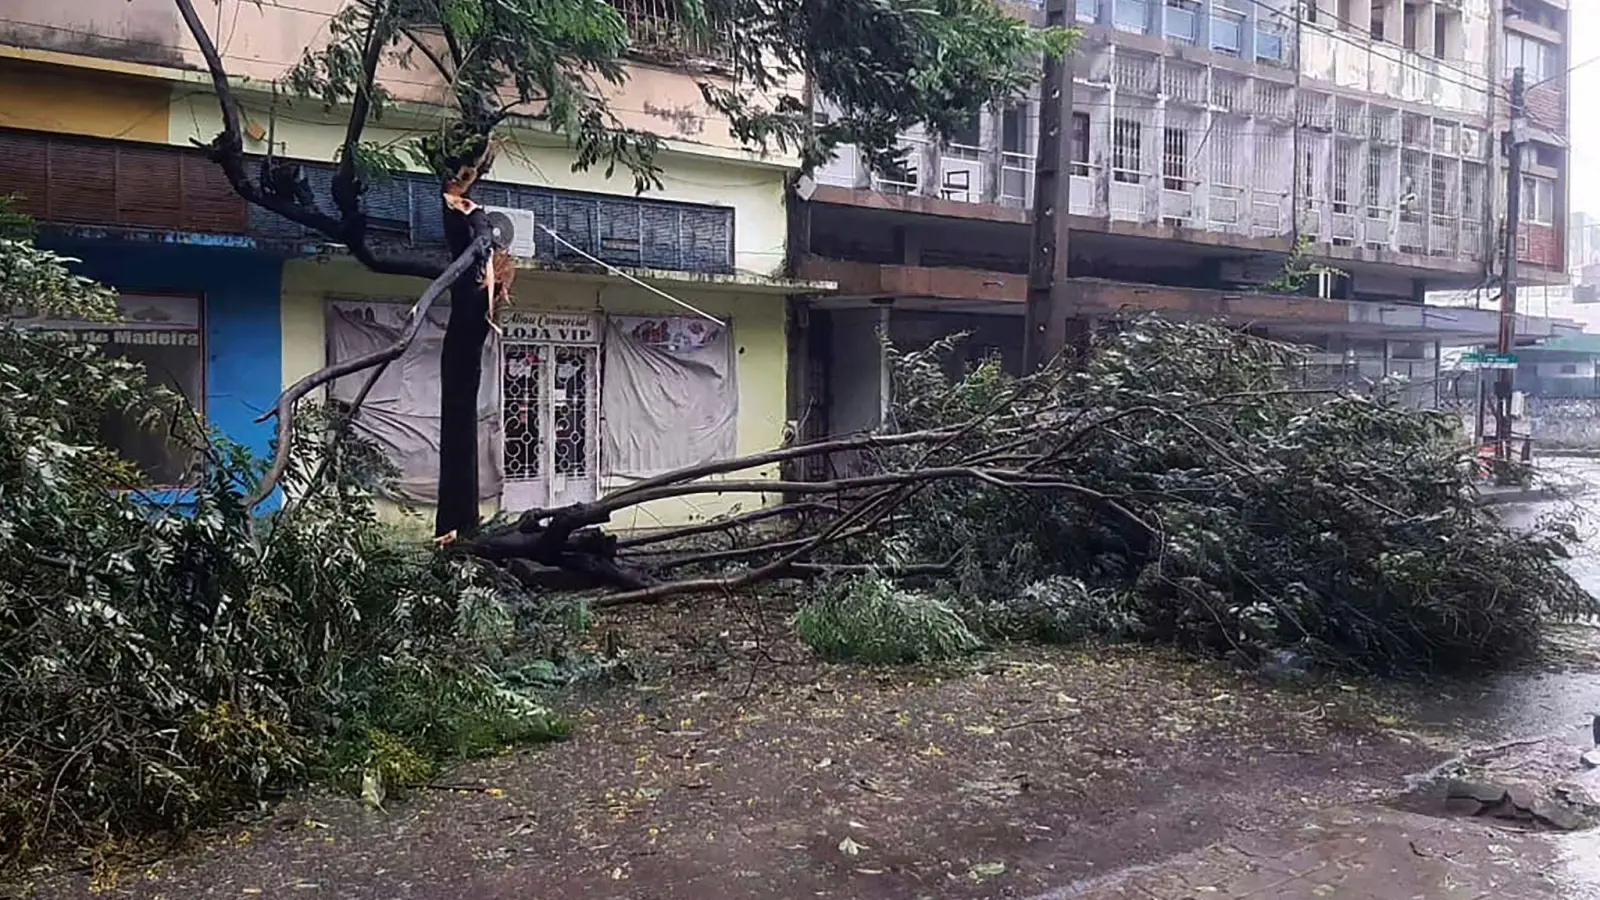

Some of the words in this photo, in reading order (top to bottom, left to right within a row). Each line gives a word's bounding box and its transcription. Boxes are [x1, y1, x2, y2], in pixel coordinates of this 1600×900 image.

[82, 331, 109, 343] de
[114, 331, 199, 346] Madeira
[502, 327, 551, 339] LOJA
[559, 328, 592, 340] VIP
